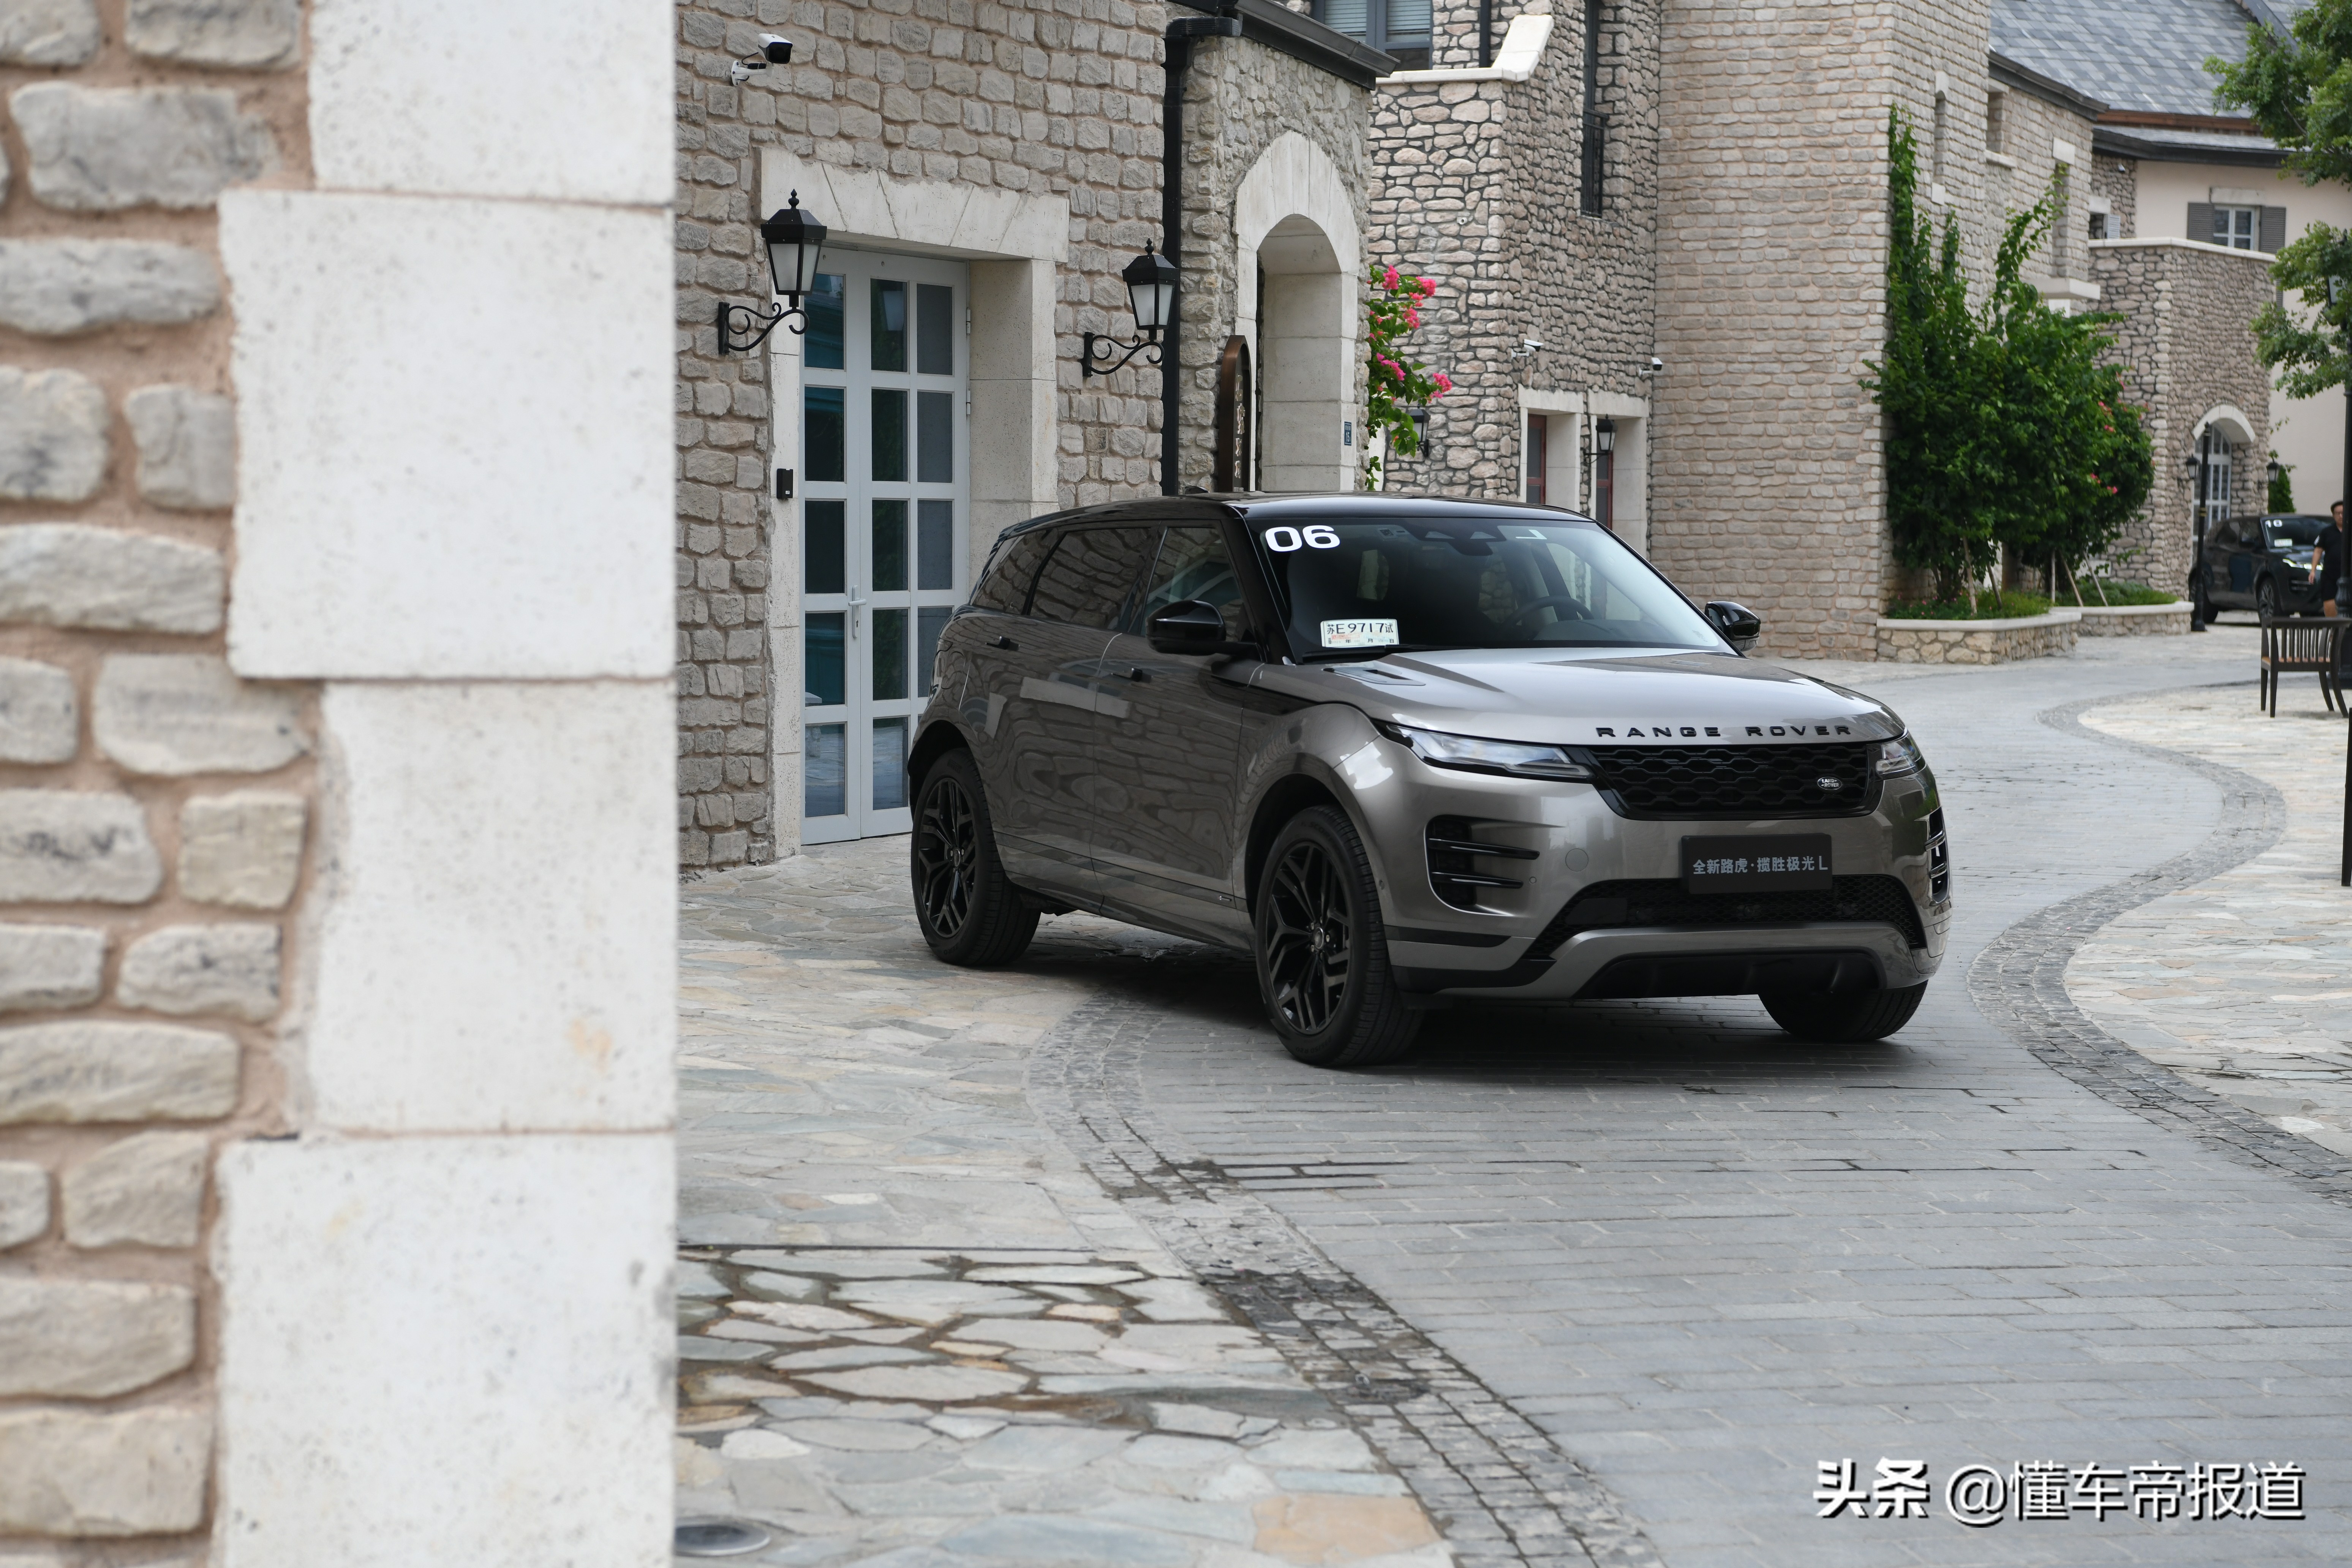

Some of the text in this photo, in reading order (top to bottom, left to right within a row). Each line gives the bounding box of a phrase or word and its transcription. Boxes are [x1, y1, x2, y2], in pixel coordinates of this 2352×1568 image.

[2265, 519, 2282, 528] 10
[1265, 525, 1340, 552] 06
[1326, 623, 1393, 634] 苏E9717试
[1596, 725, 1851, 738] RANGE ROVER
